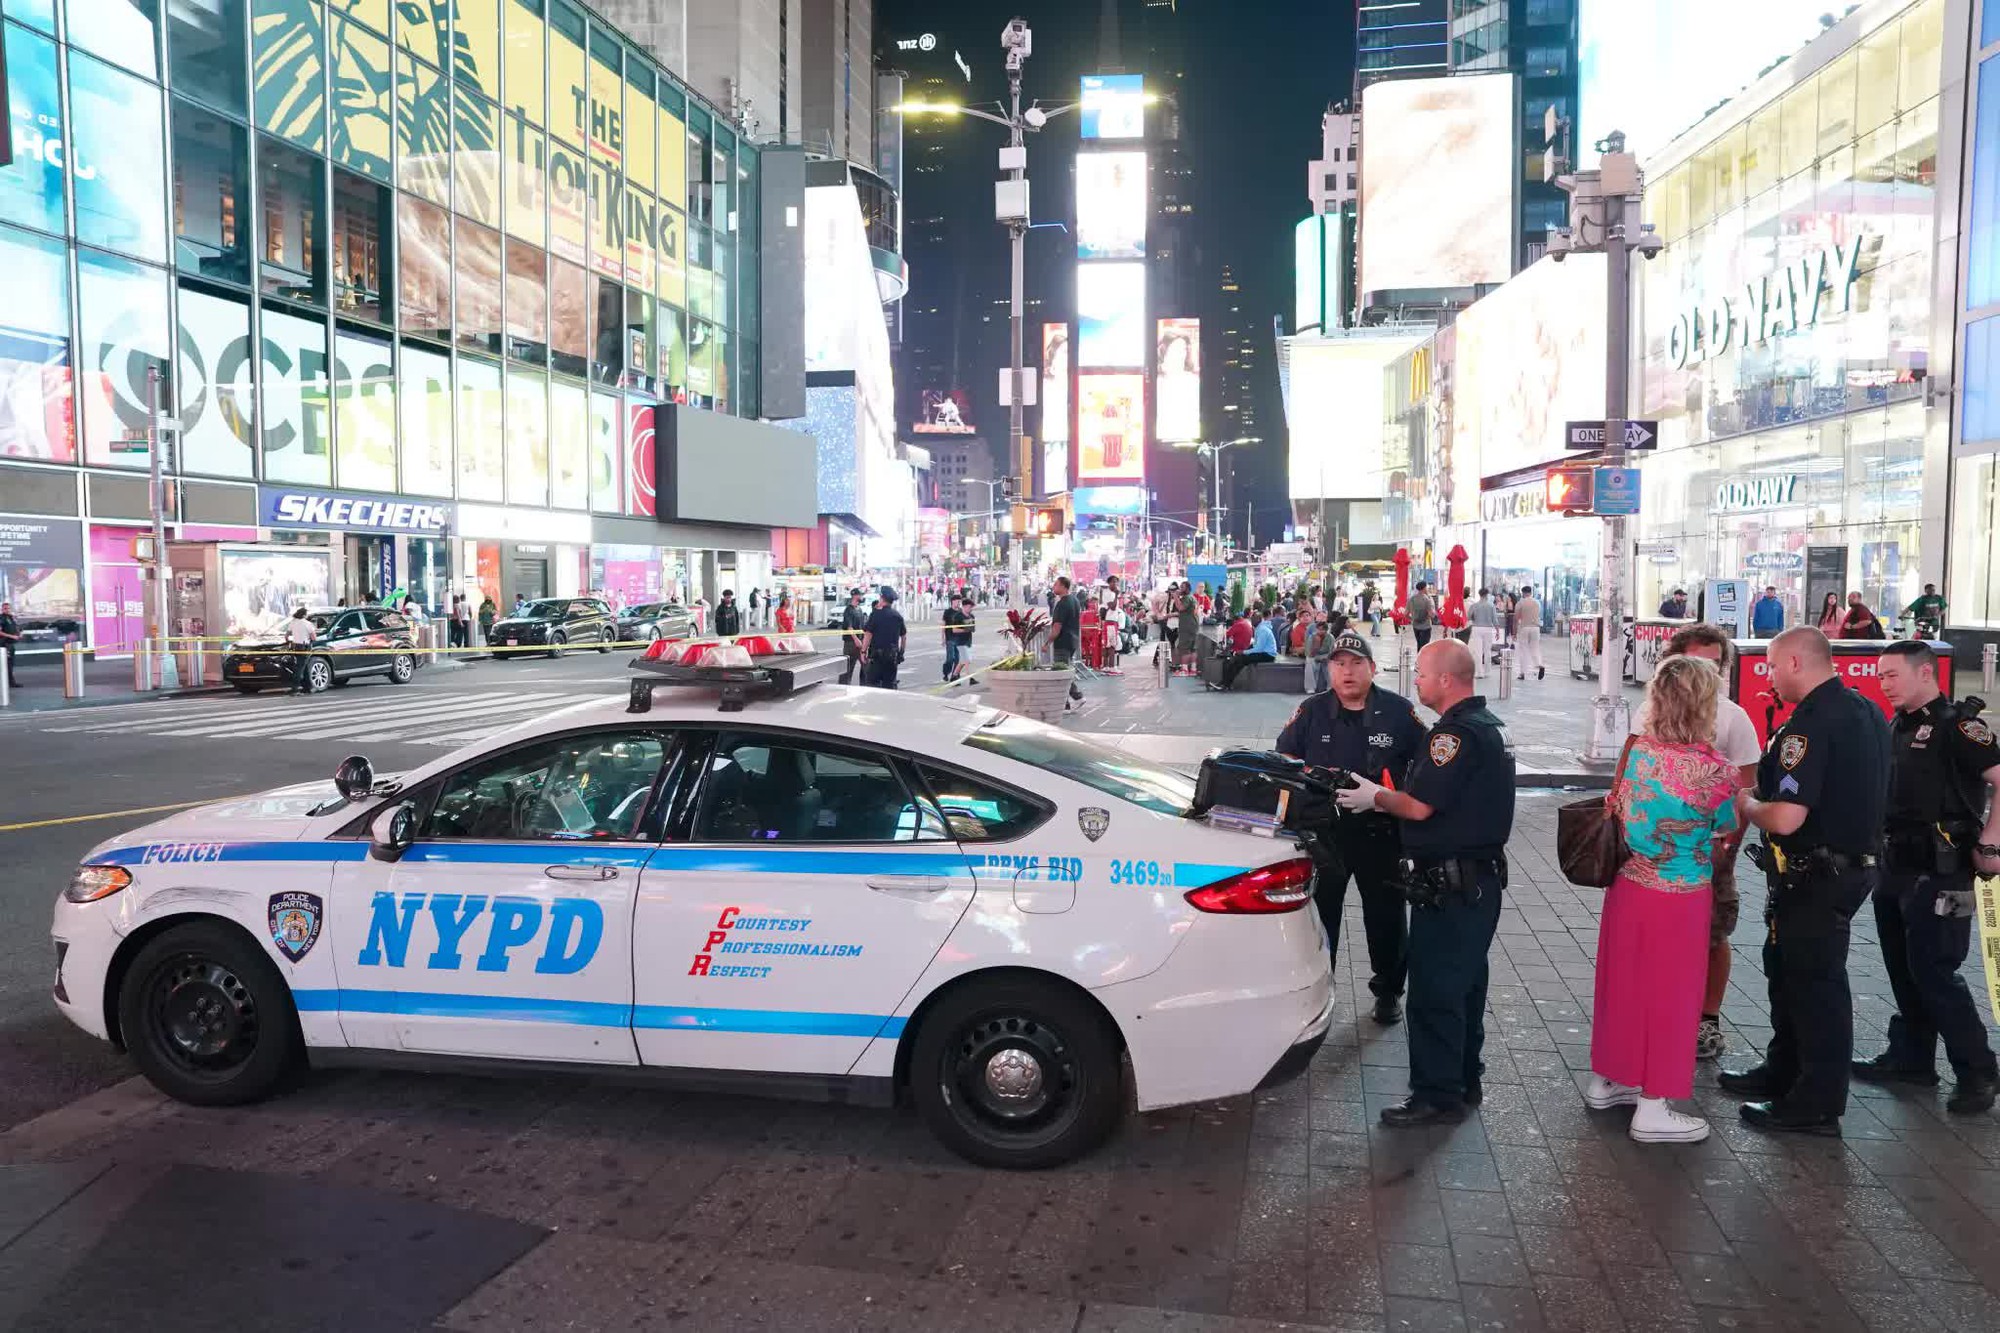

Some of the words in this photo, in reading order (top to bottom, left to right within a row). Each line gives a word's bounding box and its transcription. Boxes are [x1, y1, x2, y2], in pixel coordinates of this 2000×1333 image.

[572, 84, 621, 152] THE
[516, 105, 600, 222] LION
[606, 160, 676, 260] KING
[1666, 295, 1730, 371] OLD
[1735, 234, 1863, 349] NAVY
[215, 334, 399, 467] CBS
[1578, 430, 1605, 441] ONE
[1626, 430, 1643, 441] AY
[1716, 483, 1748, 510] OLD
[1747, 474, 1797, 507] NAVY
[277, 494, 446, 529] SKECHERS
[1570, 621, 1594, 634] CHICA
[1635, 625, 1679, 640] CHICAG
[1334, 637, 1362, 649] NYPD
[1848, 662, 1878, 677] CH
[1368, 735, 1393, 743] POLICE
[142, 842, 224, 865] POLICE
[1048, 857, 1083, 882] BID
[1110, 859, 1159, 885] 3469
[271, 900, 319, 914] DEPARTMENT
[283, 893, 309, 902] POLICE
[358, 890, 604, 975] NYPD
[277, 938, 286, 949] OF
[302, 936, 315, 953] NEW
